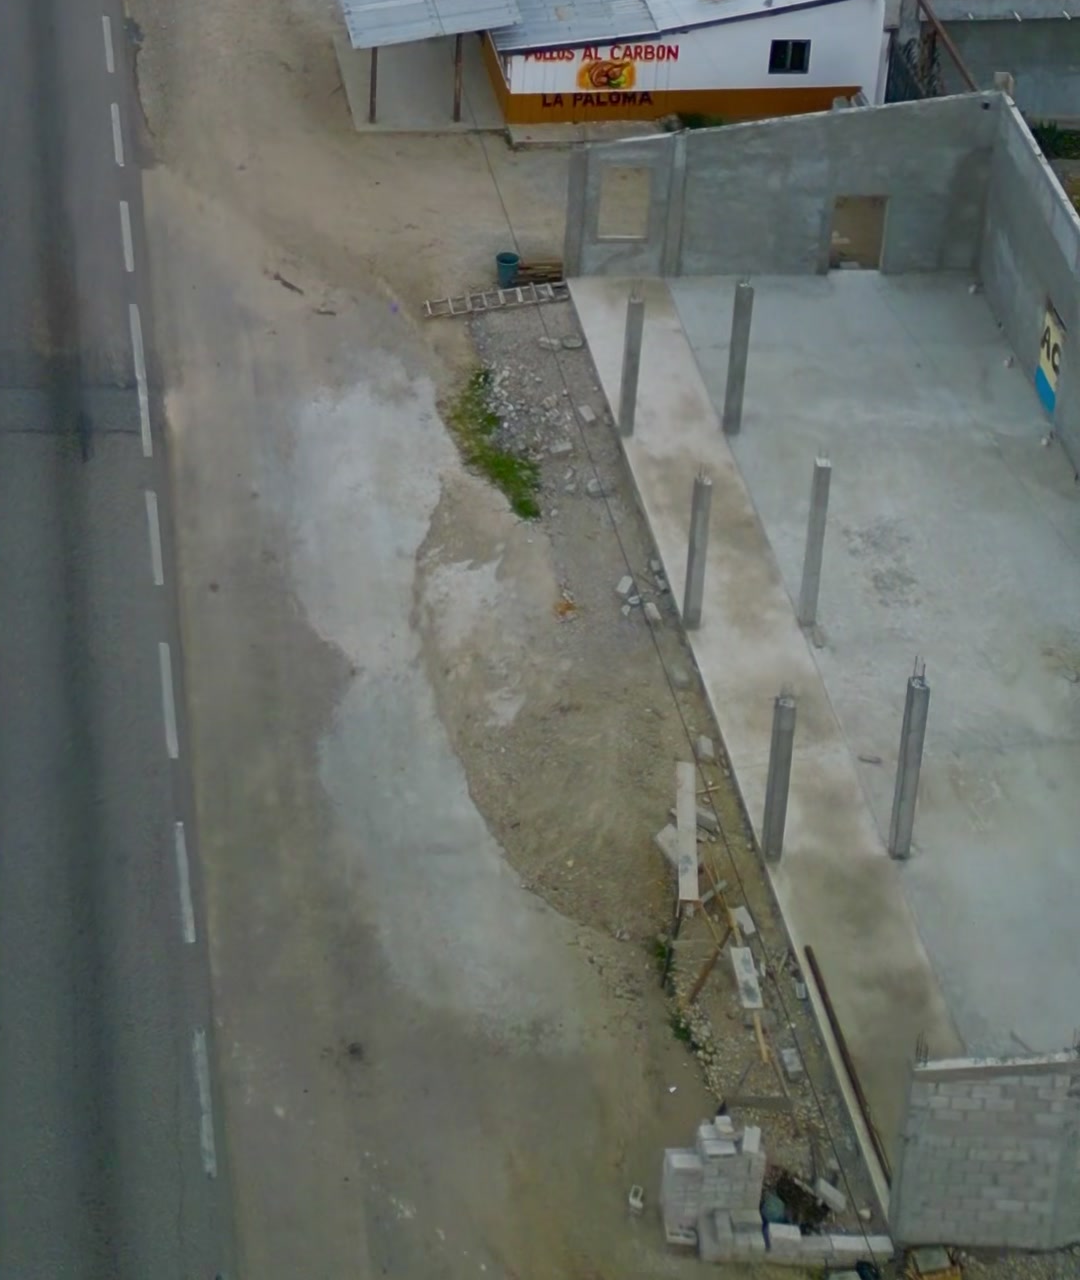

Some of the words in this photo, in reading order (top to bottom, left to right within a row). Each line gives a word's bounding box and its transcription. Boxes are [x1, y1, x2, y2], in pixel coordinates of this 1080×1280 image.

[582, 45, 602, 61] AL
[610, 44, 679, 61] CARBON
[542, 92, 564, 108] LA
[573, 91, 653, 108] PALOMA
